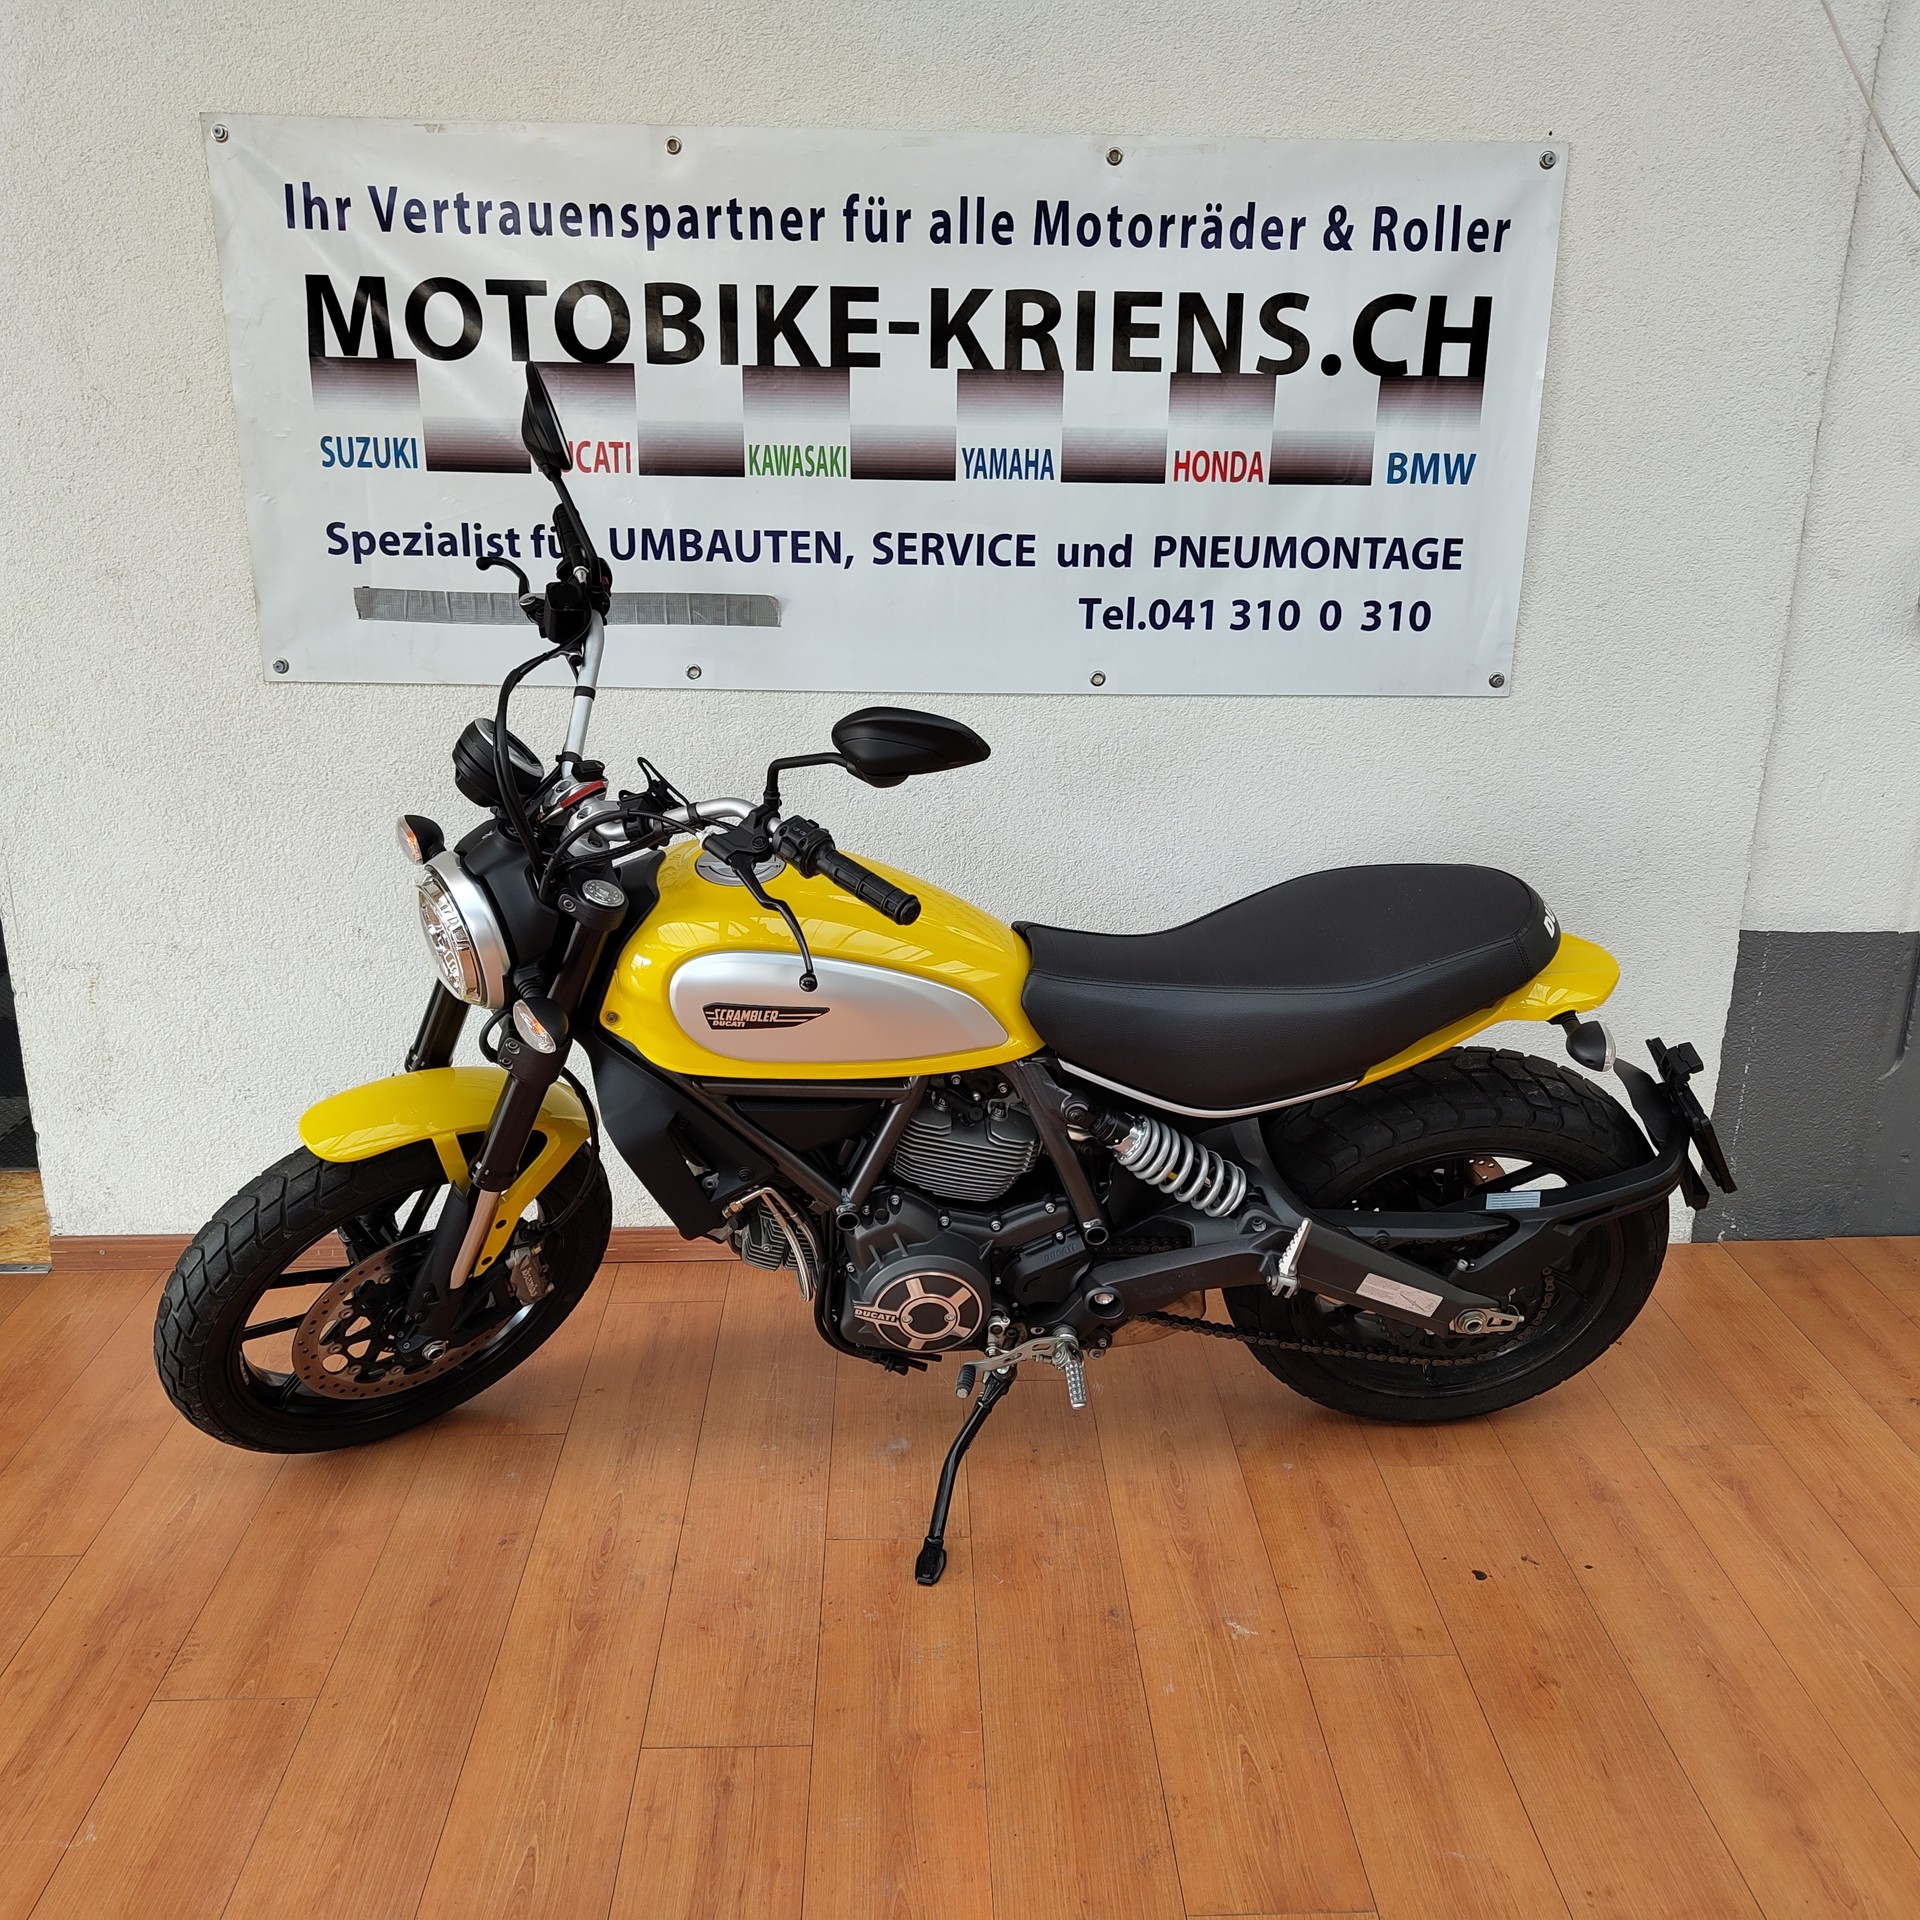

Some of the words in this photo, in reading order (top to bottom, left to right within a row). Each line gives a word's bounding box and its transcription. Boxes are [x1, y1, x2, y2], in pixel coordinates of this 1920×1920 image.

[285, 181, 352, 232] Ihr
[367, 185, 826, 251] Vertrauenspartner
[843, 193, 913, 245] für
[929, 195, 1015, 246] alle
[1033, 200, 1306, 251] Motorräder
[1322, 204, 1355, 252] &
[1372, 204, 1512, 253] Roller
[304, 273, 1493, 379] MOTOBIKE-KRIENS.CH
[319, 435, 419, 470] SUZUKI
[747, 441, 848, 478] KAWASAKI
[961, 447, 1055, 481] YAMAHA
[1173, 450, 1264, 484] HONDA
[1386, 452, 1477, 486] BMW
[326, 519, 522, 564] Spezialist
[608, 527, 855, 570] UMBAUTEN,
[872, 532, 1036, 567] SERVICE
[1057, 533, 1133, 569] und
[1153, 535, 1464, 571] PNEUMONTAGE
[1078, 597, 1214, 632] Tel.041
[1229, 599, 1301, 632] 310
[1319, 600, 1342, 632] 0
[1360, 600, 1432, 632] 310
[712, 1020, 746, 1028] DUCATI
[713, 1008, 779, 1022] SCRAMBLER
[854, 1308, 896, 1322] DUCATI
